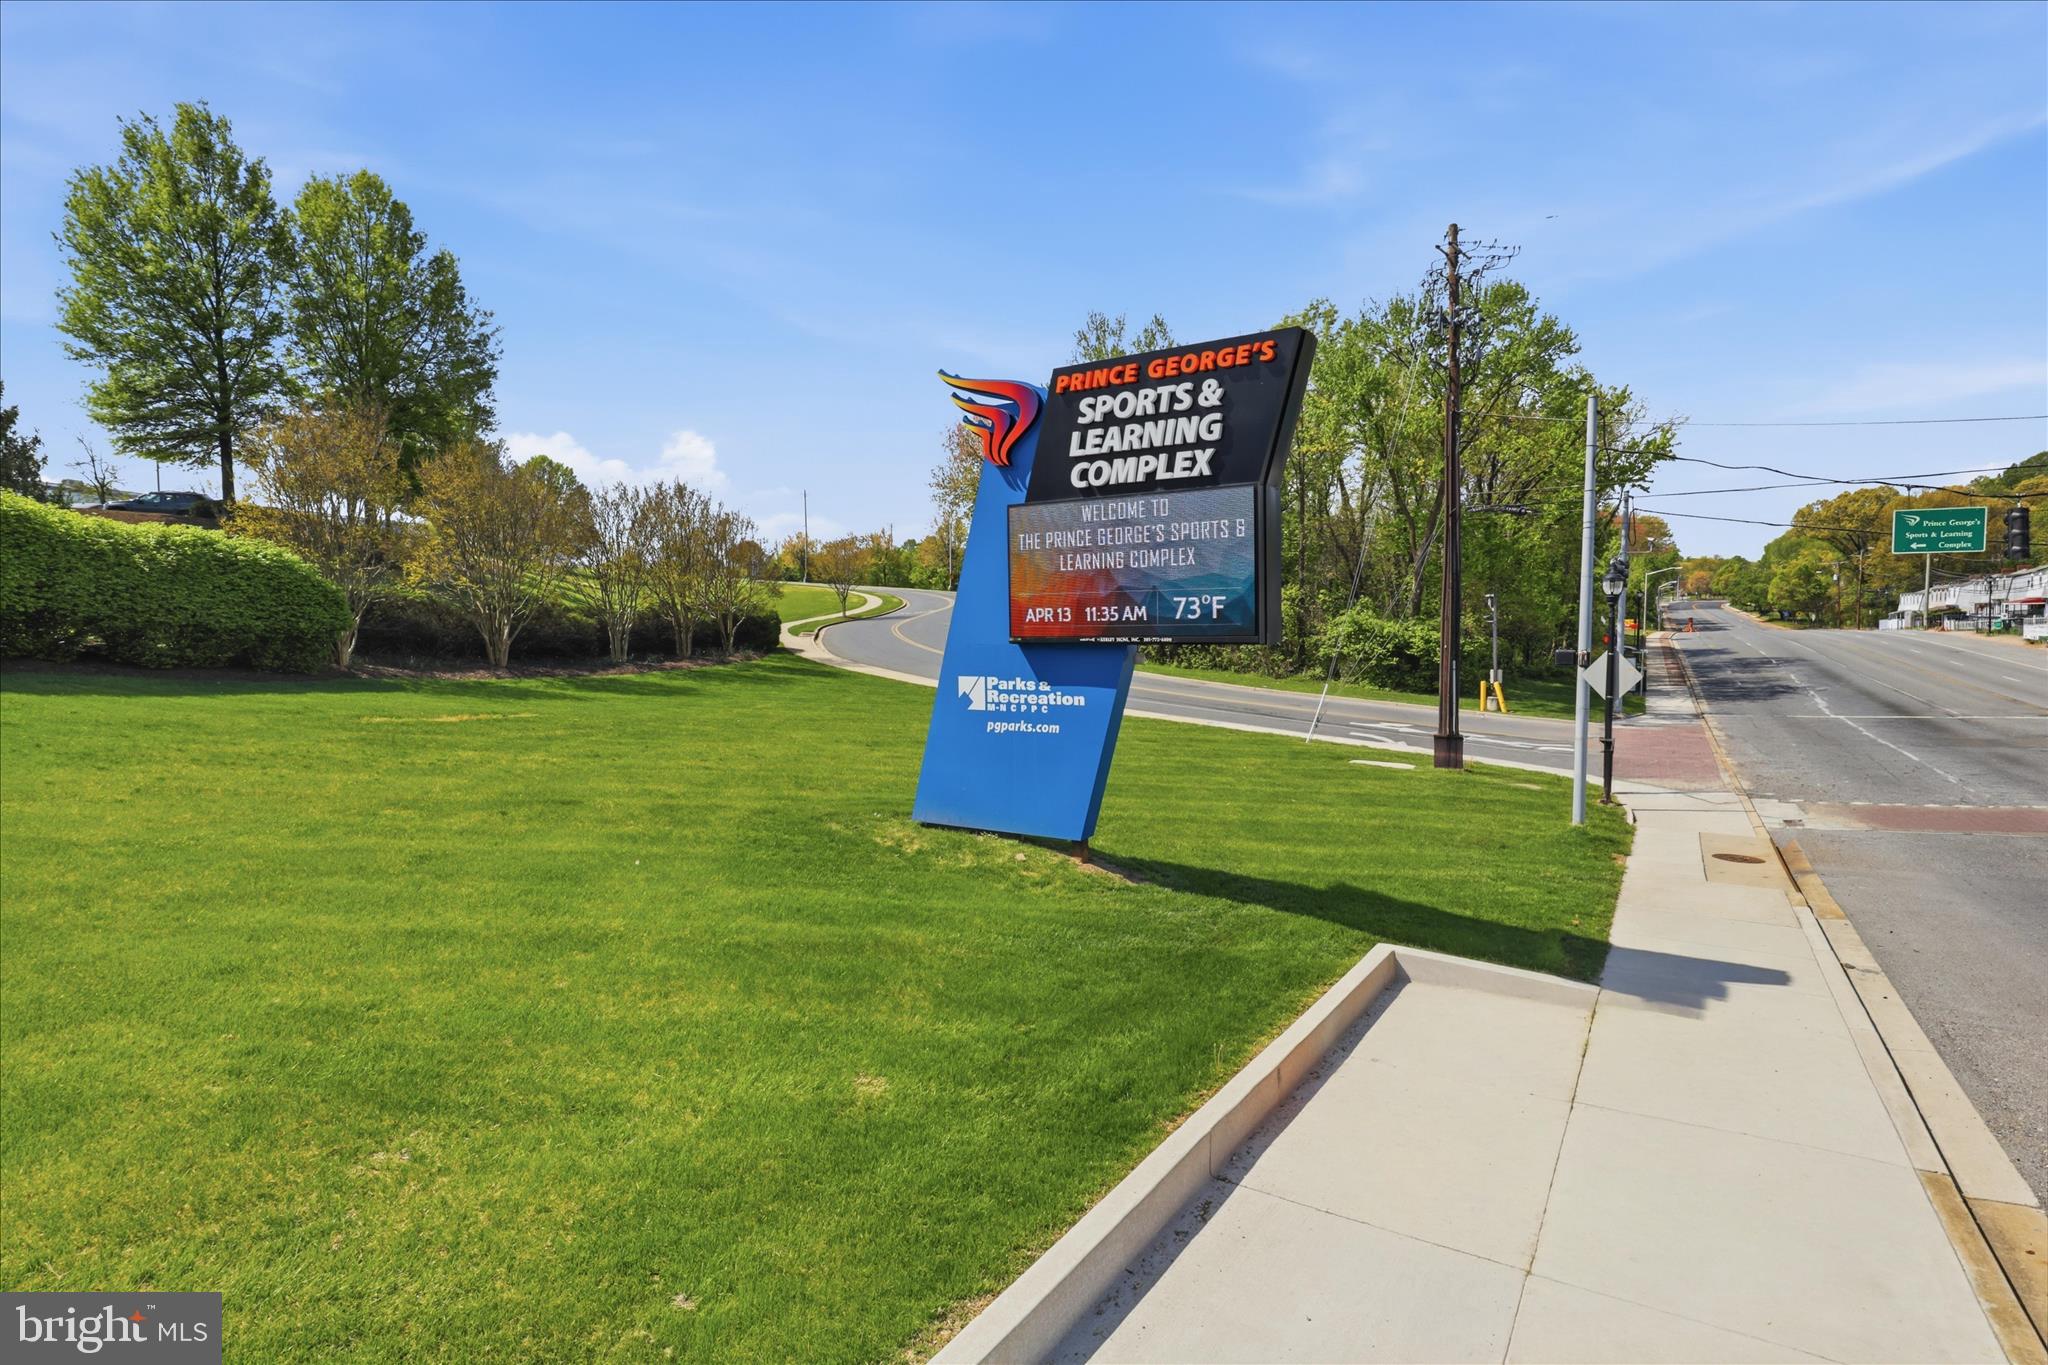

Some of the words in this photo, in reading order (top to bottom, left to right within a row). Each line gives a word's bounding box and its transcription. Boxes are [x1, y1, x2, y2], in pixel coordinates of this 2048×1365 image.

[1056, 363, 1140, 394] PRINCE
[1147, 340, 1278, 380] GEORGE'S
[1077, 382, 1194, 425] SPORTS
[1198, 378, 1225, 408] &
[1069, 412, 1224, 457] LEARNING
[1070, 448, 1216, 488] COMPLEX
[1081, 500, 1147, 523] WELCOME
[1153, 498, 1169, 517] TO
[1949, 518, 1981, 527] George's
[1018, 531, 1041, 551] THE
[1045, 528, 1093, 549] PRINCE
[1097, 523, 1165, 546] GEORGE'S
[1171, 520, 1229, 541] SPORTS
[1236, 518, 1245, 537] &
[1905, 531, 1928, 539] Sports
[1940, 530, 1973, 538] Learning
[1938, 541, 1972, 549] Complex
[1059, 551, 1124, 571] LEARNING
[1129, 547, 1196, 568] COMPLEX
[1025, 607, 1054, 623] APR
[1057, 607, 1072, 622] 13
[1085, 606, 1118, 622] 11:35
[1122, 605, 1147, 621] AM
[1173, 594, 1227, 620] 73°F
[986, 676, 1036, 691] Parks
[1038, 681, 1051, 692] &
[986, 690, 1086, 706] Recreation
[986, 720, 1060, 734] pgparks.com
